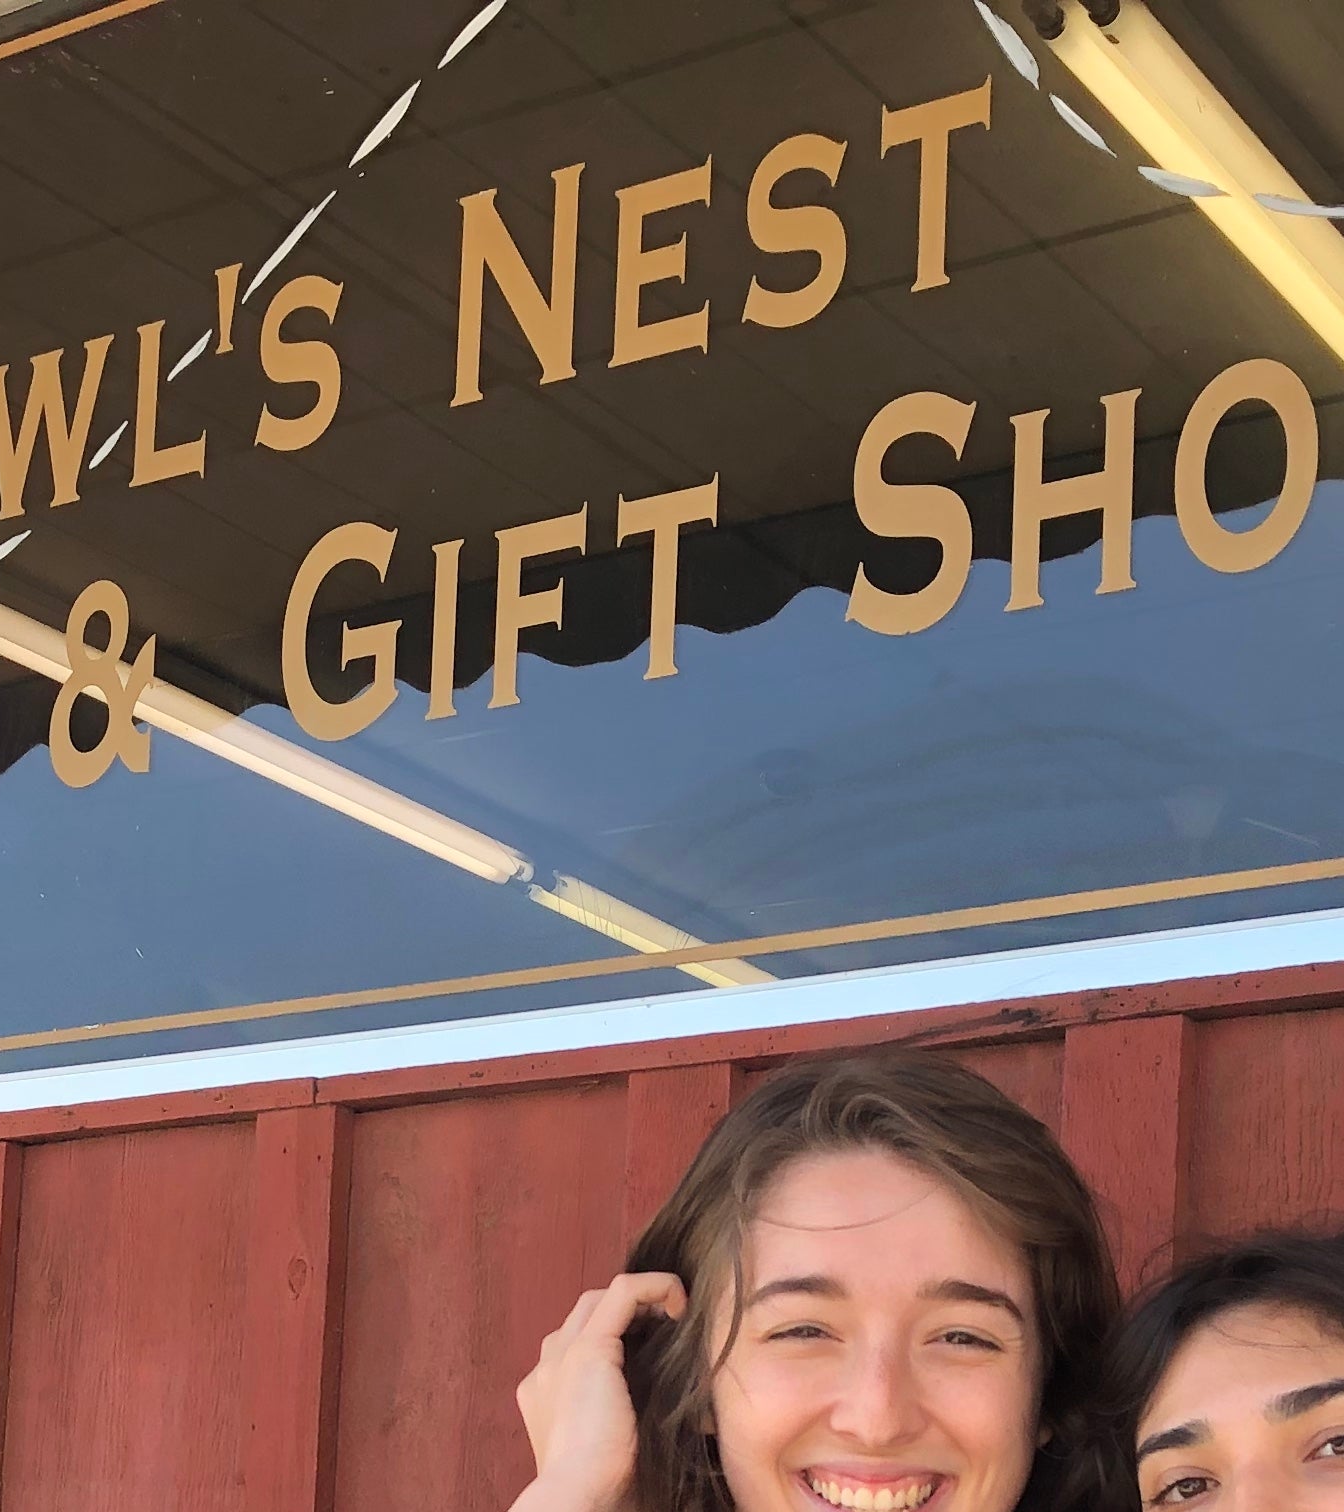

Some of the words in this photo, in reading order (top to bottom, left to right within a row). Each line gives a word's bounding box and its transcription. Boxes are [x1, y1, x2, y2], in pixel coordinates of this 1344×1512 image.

[451, 74, 990, 408] NEST
[51, 579, 156, 788] &
[282, 473, 719, 742] GIFT
